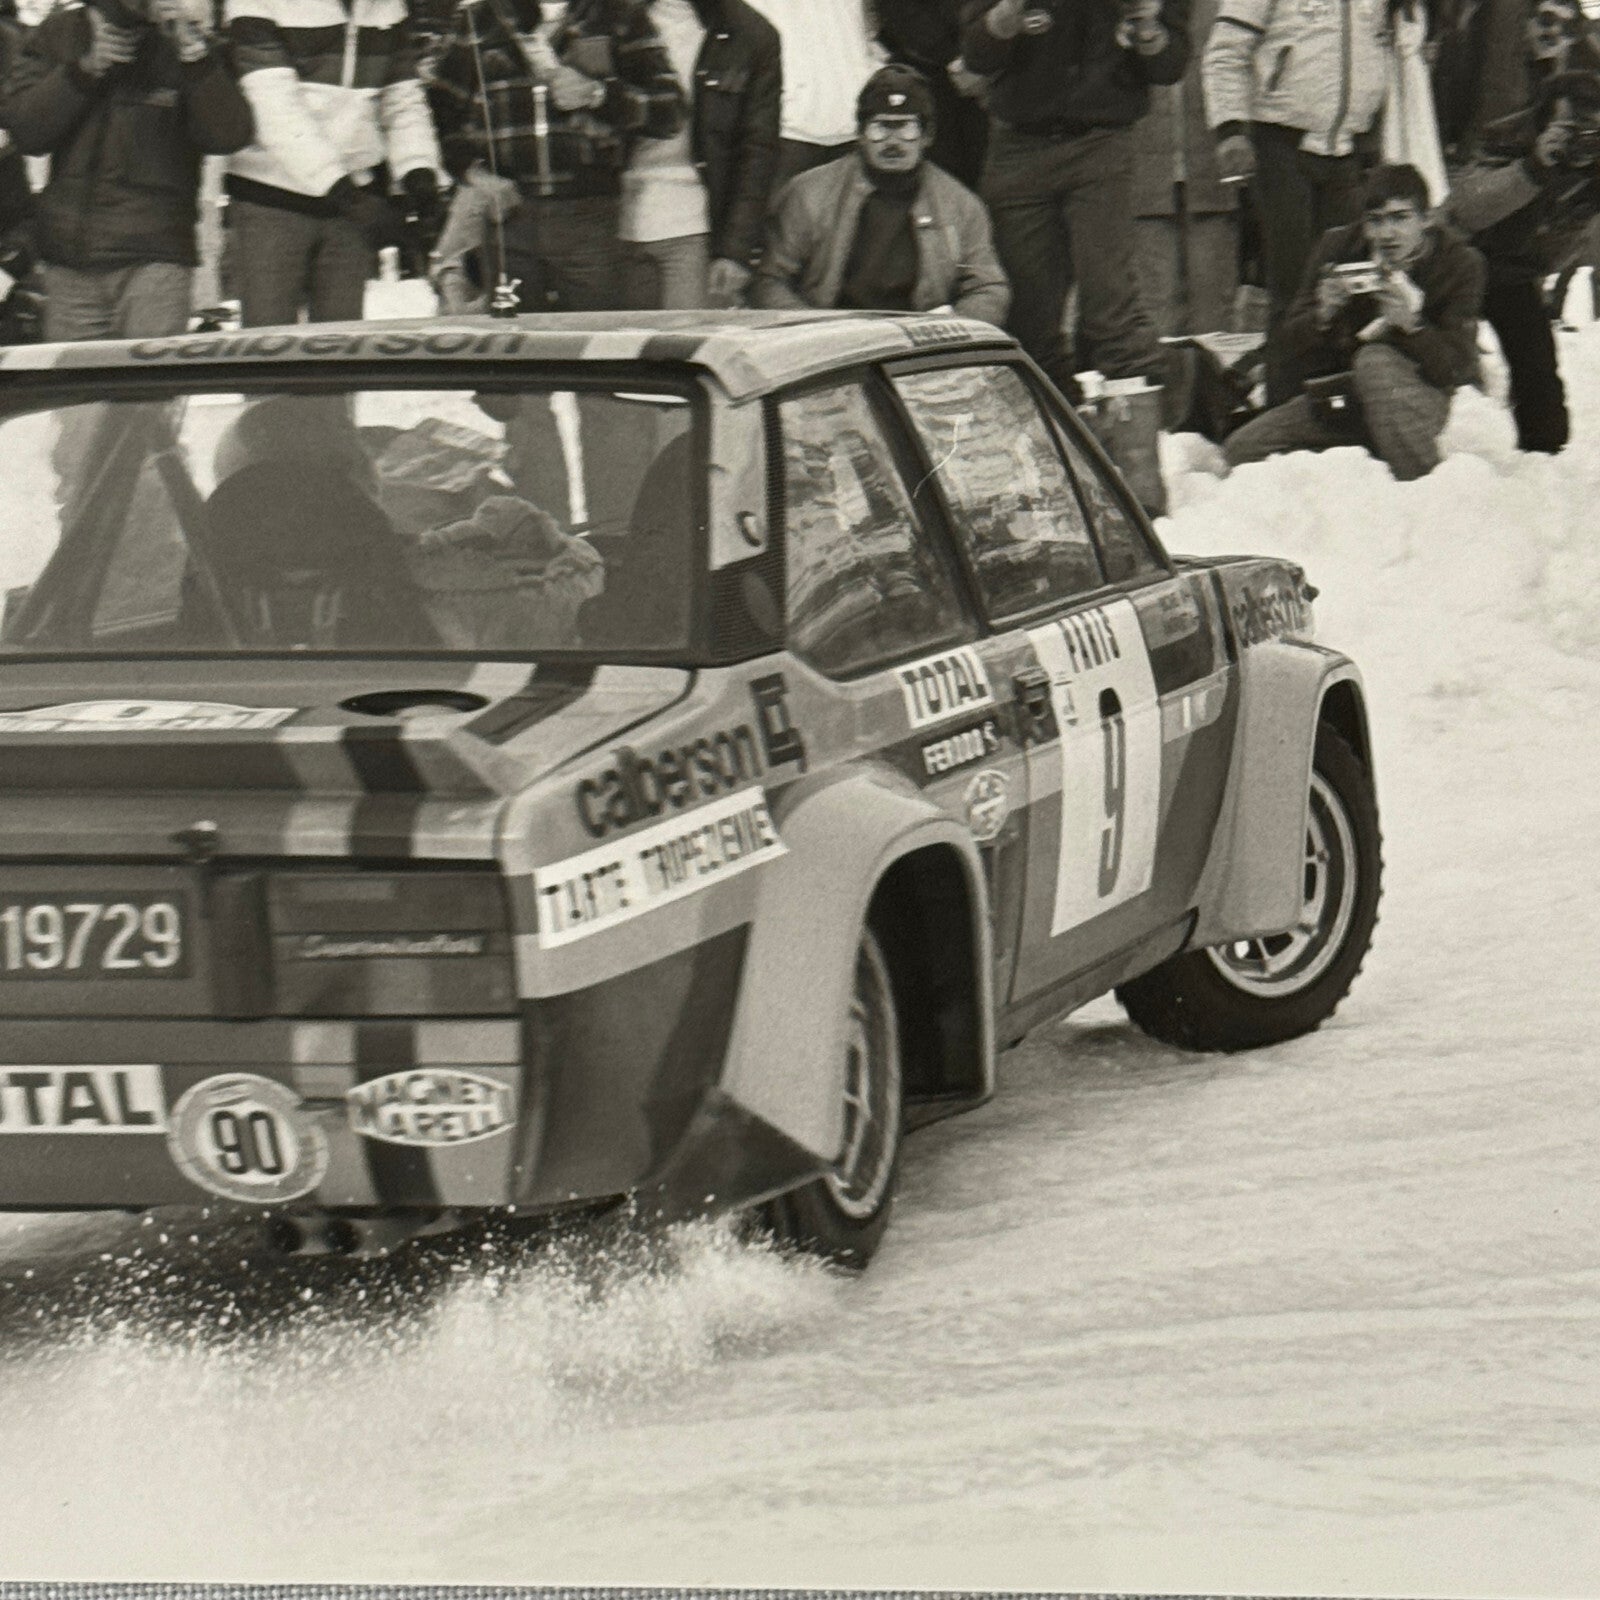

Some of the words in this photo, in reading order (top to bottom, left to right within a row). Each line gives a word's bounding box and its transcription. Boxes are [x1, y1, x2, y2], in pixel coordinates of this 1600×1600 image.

[901, 653, 988, 719] TOTAL
[574, 724, 764, 839] calberson
[1, 904, 181, 971] 19729
[0, 1071, 154, 1127] TAL
[212, 1110, 284, 1176] 90
